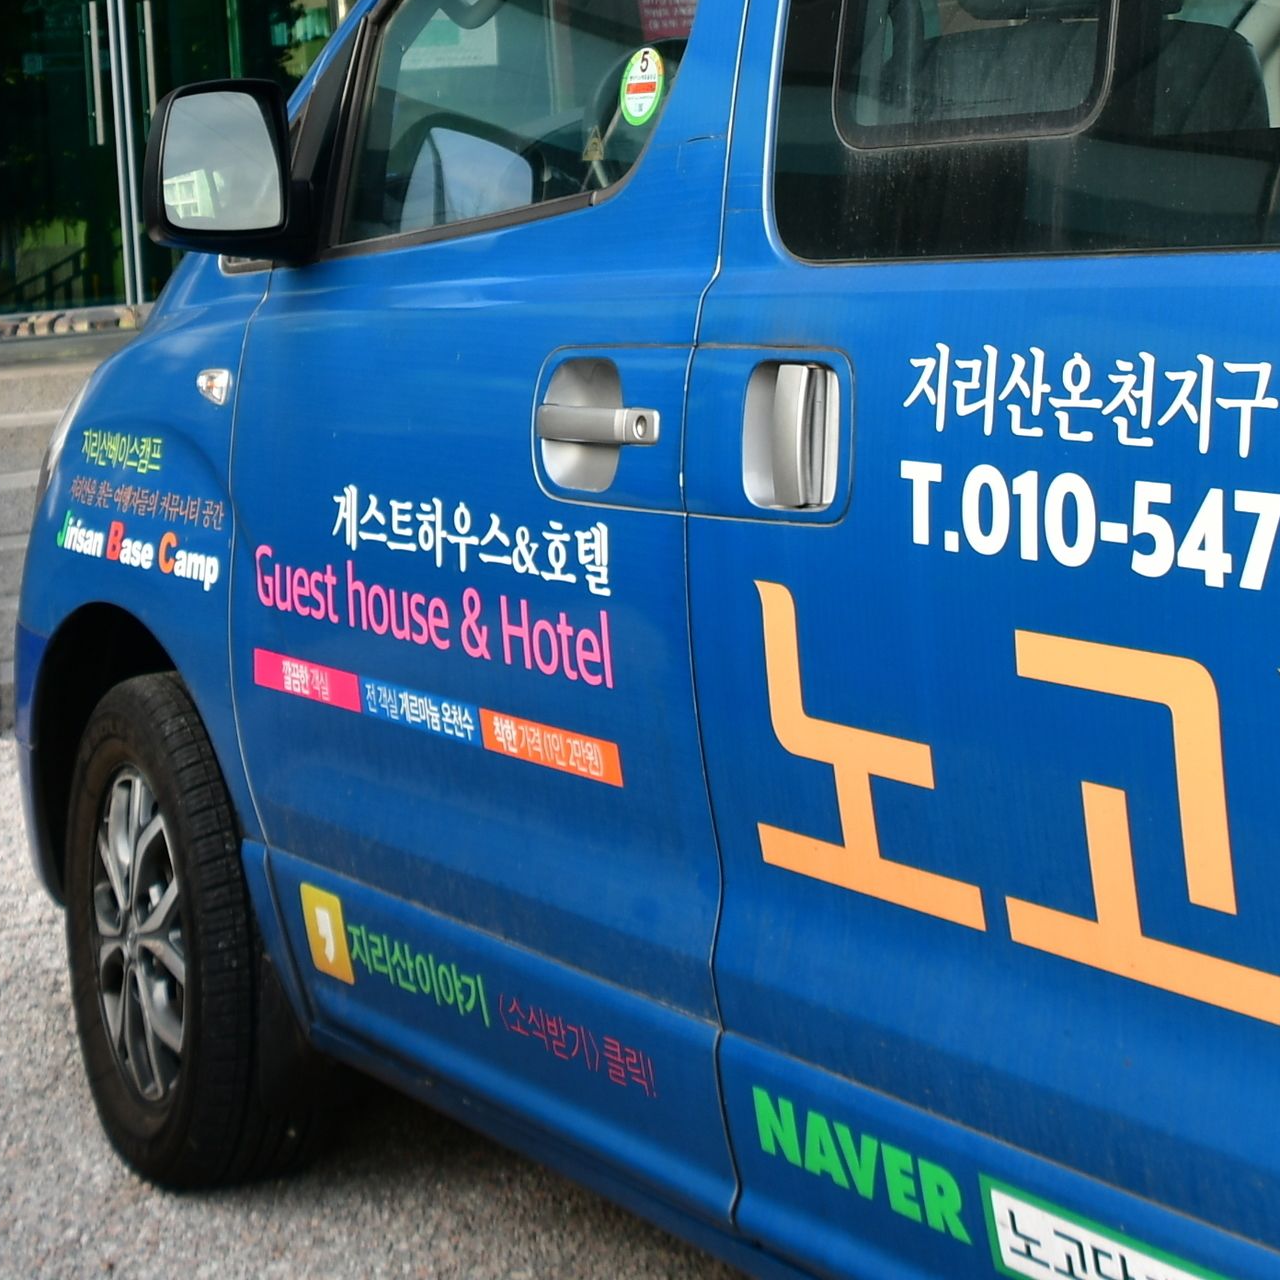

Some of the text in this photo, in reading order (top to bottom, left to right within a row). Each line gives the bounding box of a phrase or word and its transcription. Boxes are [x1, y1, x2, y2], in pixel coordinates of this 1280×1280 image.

[639, 50, 650, 73] 5
[902, 341, 1280, 460] 지리산온천지구
[81, 428, 163, 475] 지리산베이스캠프
[113, 484, 160, 519] 여행자들의
[160, 492, 201, 528] 커뮤니티
[202, 500, 224, 531] 공간
[56, 509, 219, 592] Jirisan Base Camp
[332, 483, 612, 598] 게스트하우스&호텔
[254, 544, 615, 689] Guest house & Hotel
[309, 669, 330, 702] 객실
[364, 683, 475, 742] 전 객실 게르마늄 온천수
[493, 717, 518, 754] 착한
[517, 725, 543, 762] 가격
[347, 923, 491, 1030] 지리산이야기
[601, 1034, 660, 1099] 클릭!
[752, 1085, 973, 1246] NAVER
